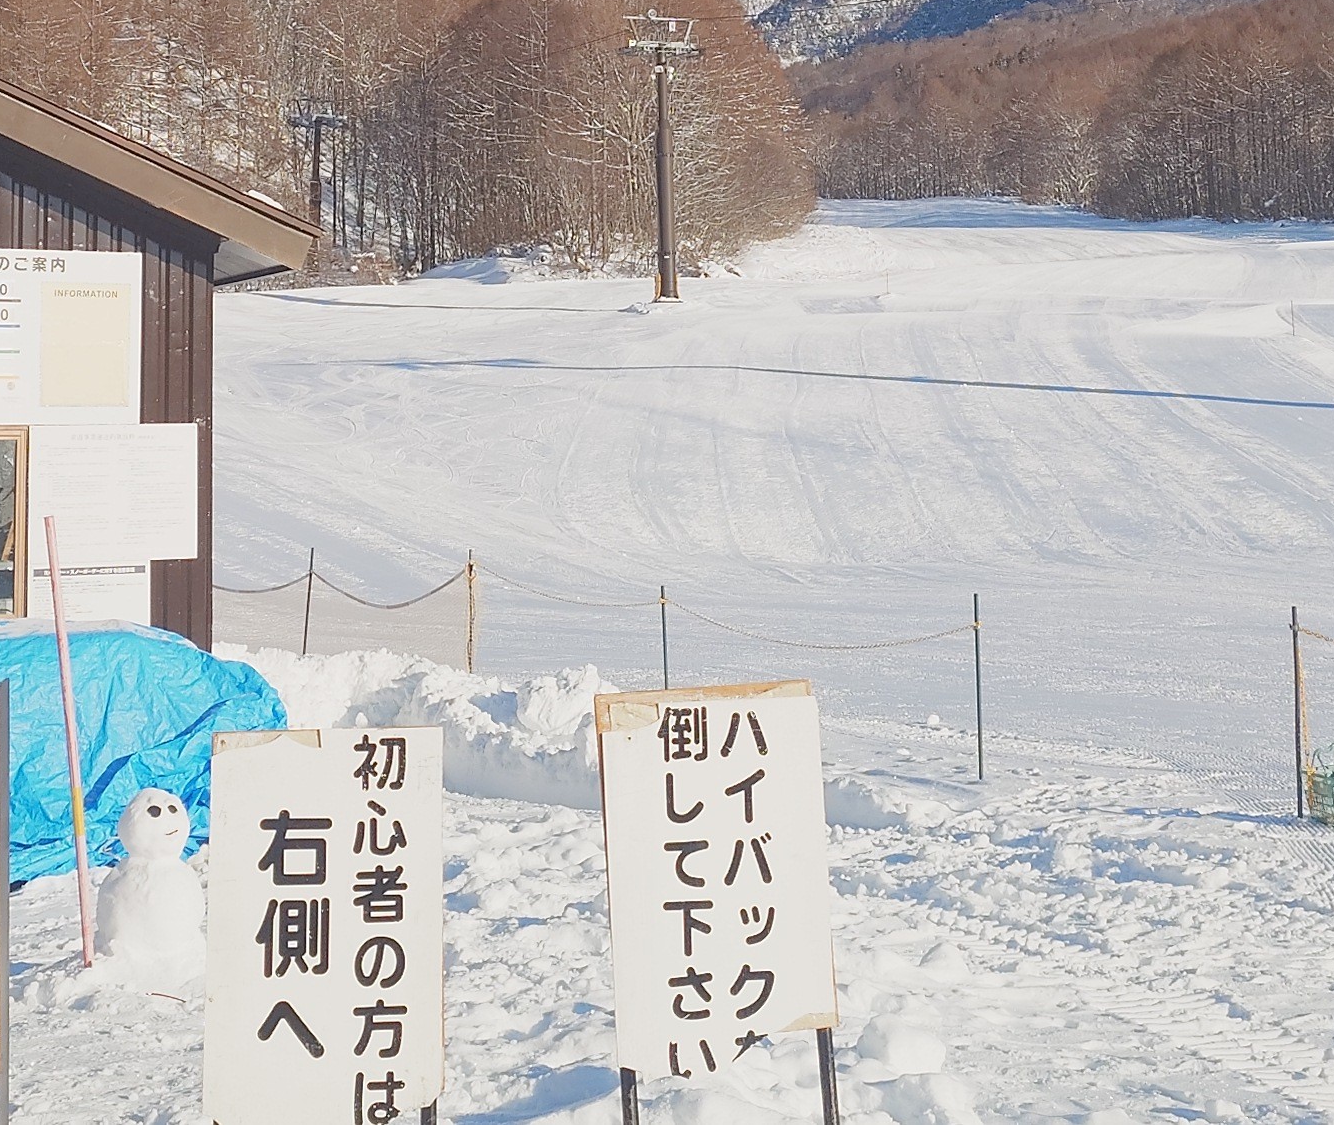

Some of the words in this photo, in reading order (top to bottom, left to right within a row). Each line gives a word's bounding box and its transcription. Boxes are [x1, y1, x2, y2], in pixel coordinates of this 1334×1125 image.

[53, 289, 119, 299] INFORMATION
[255, 809, 333, 1060] 右側へ
[351, 733, 408, 1125] 初心者の方は
[656, 705, 718, 1080] 倒して下さい
